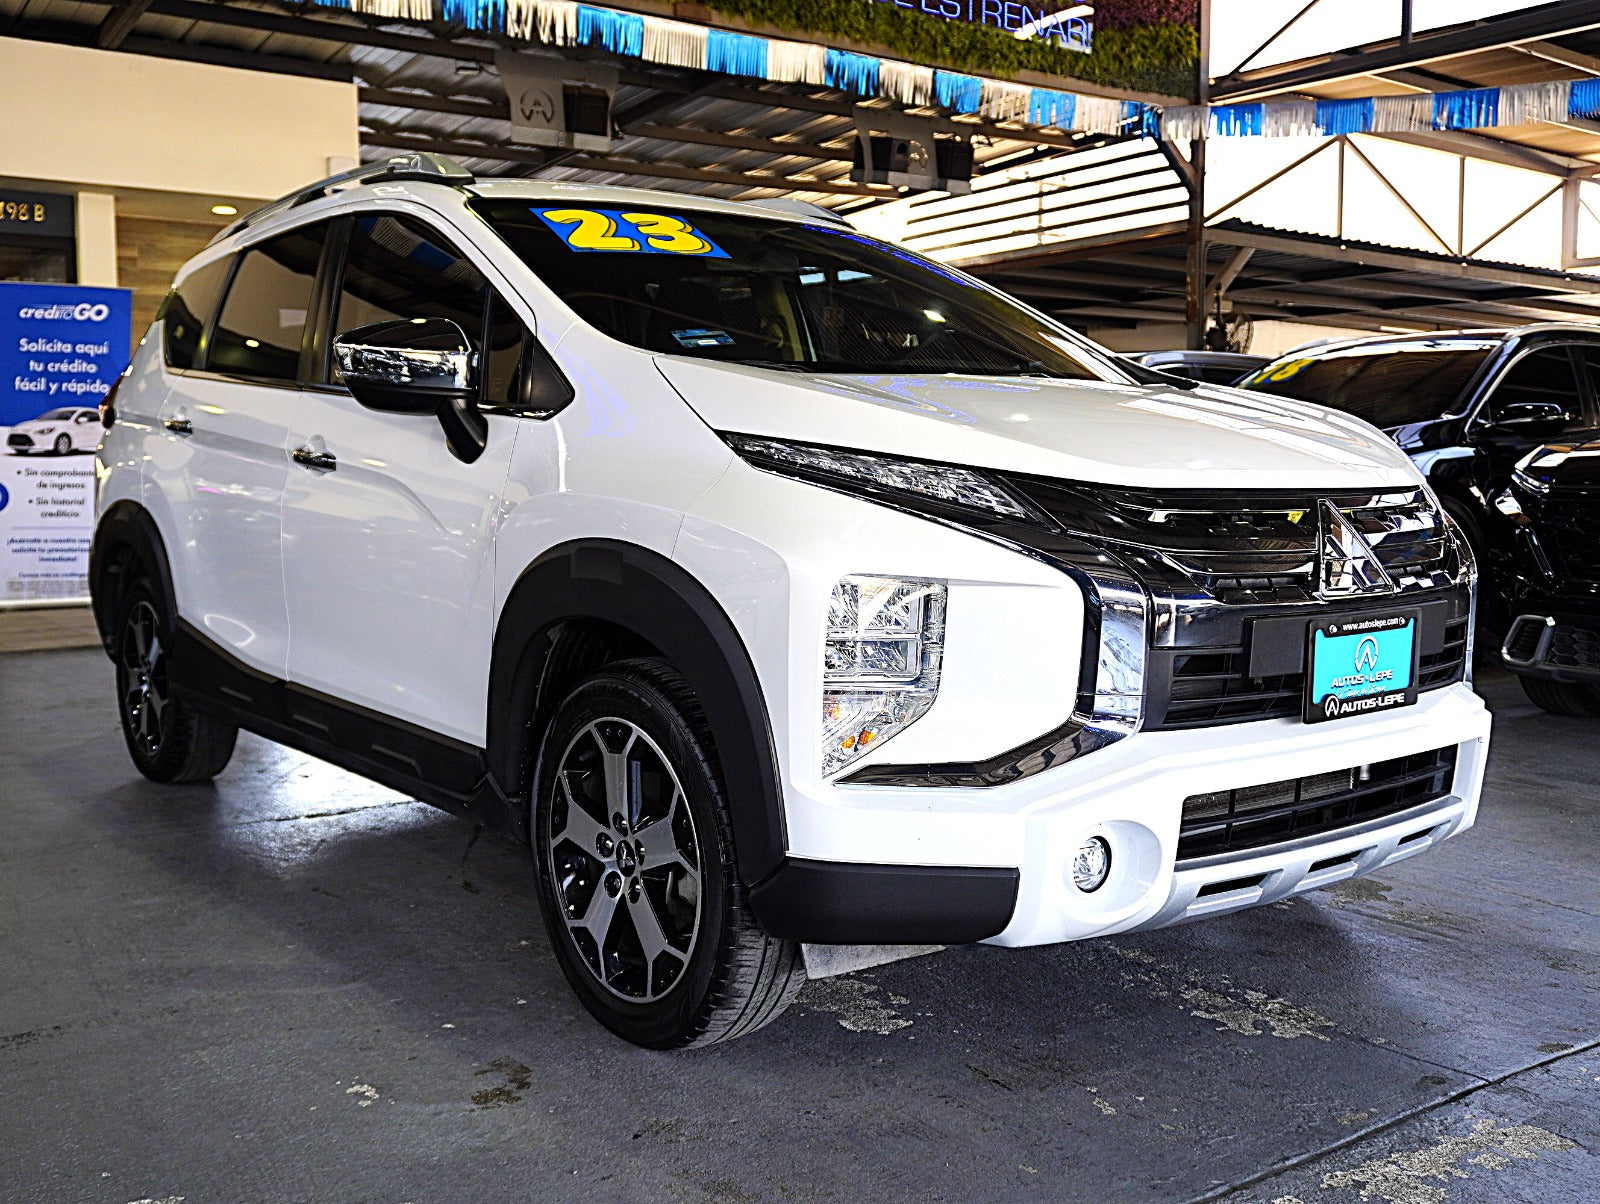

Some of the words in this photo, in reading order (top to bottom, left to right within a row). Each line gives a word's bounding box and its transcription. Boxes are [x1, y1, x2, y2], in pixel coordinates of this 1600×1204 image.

[34, 204, 45, 221] B
[542, 209, 712, 255] 23
[19, 338, 72, 353] Solicita
[75, 341, 109, 357] aquí
[29, 360, 45, 372] tu
[47, 359, 98, 374] crédito
[15, 376, 47, 391] fácil
[49, 382, 59, 395] y
[62, 379, 110, 395] rápido
[25, 468, 38, 476] Sin
[50, 481, 85, 490] ingresos
[36, 497, 48, 505] Sin
[1342, 618, 1399, 631] www.autoslepe.com
